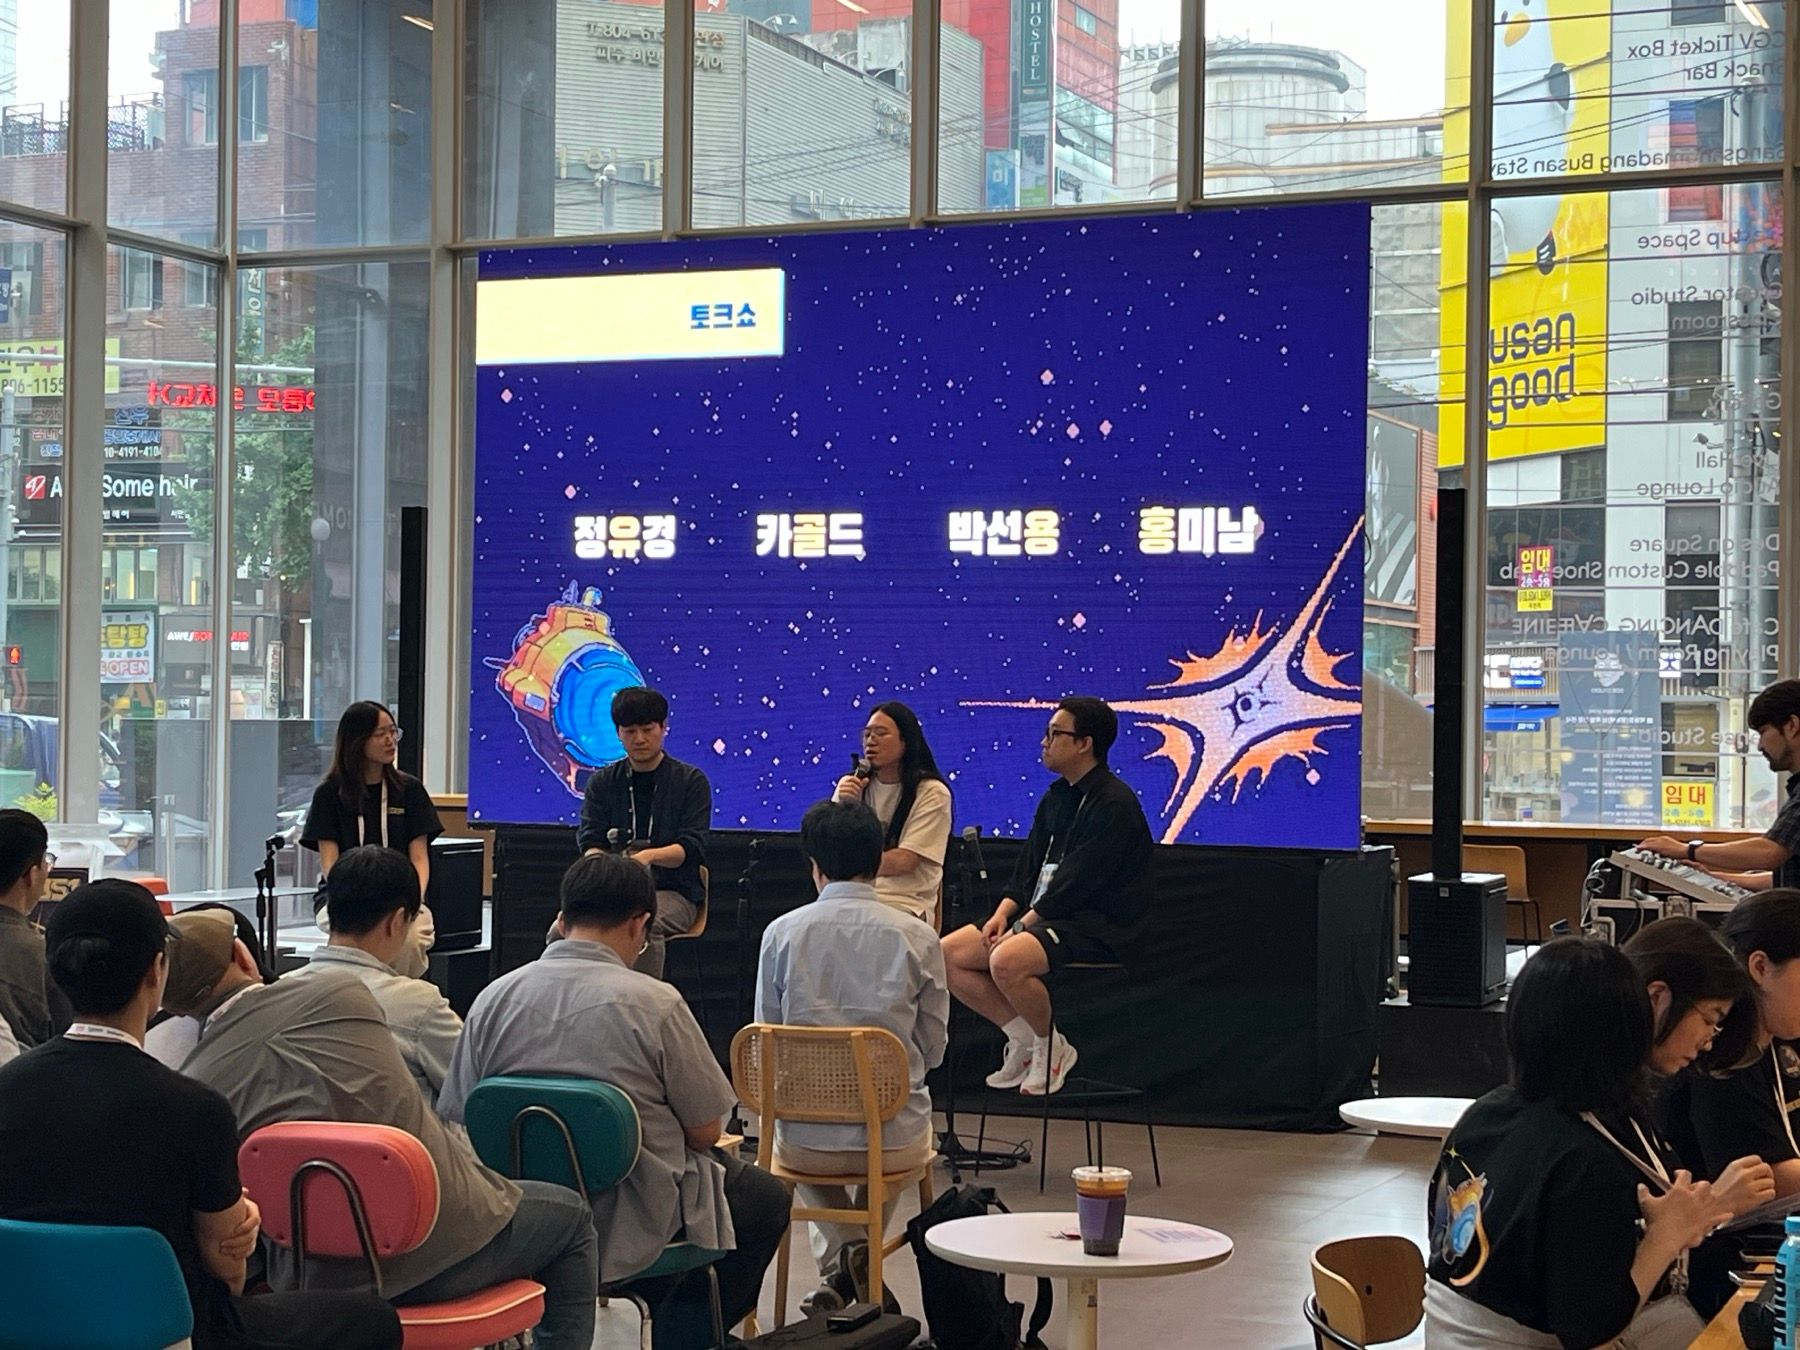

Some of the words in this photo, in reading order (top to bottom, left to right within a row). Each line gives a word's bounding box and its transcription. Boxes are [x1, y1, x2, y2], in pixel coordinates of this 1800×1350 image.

[1030, 2, 1042, 80] HOSTEL
[691, 303, 756, 329] 토크쇼
[1490, 312, 1575, 364] usan
[1488, 353, 1575, 430] good
[104, 446, 161, 459] 10-4191-410
[574, 515, 676, 558] 정유경
[756, 513, 864, 558] 카골드
[949, 510, 1060, 556] 박선용
[1138, 506, 1257, 557] 홍미남
[1521, 549, 1551, 573] 임대
[109, 659, 149, 676] OPEN
[1665, 785, 1706, 805] 임대
